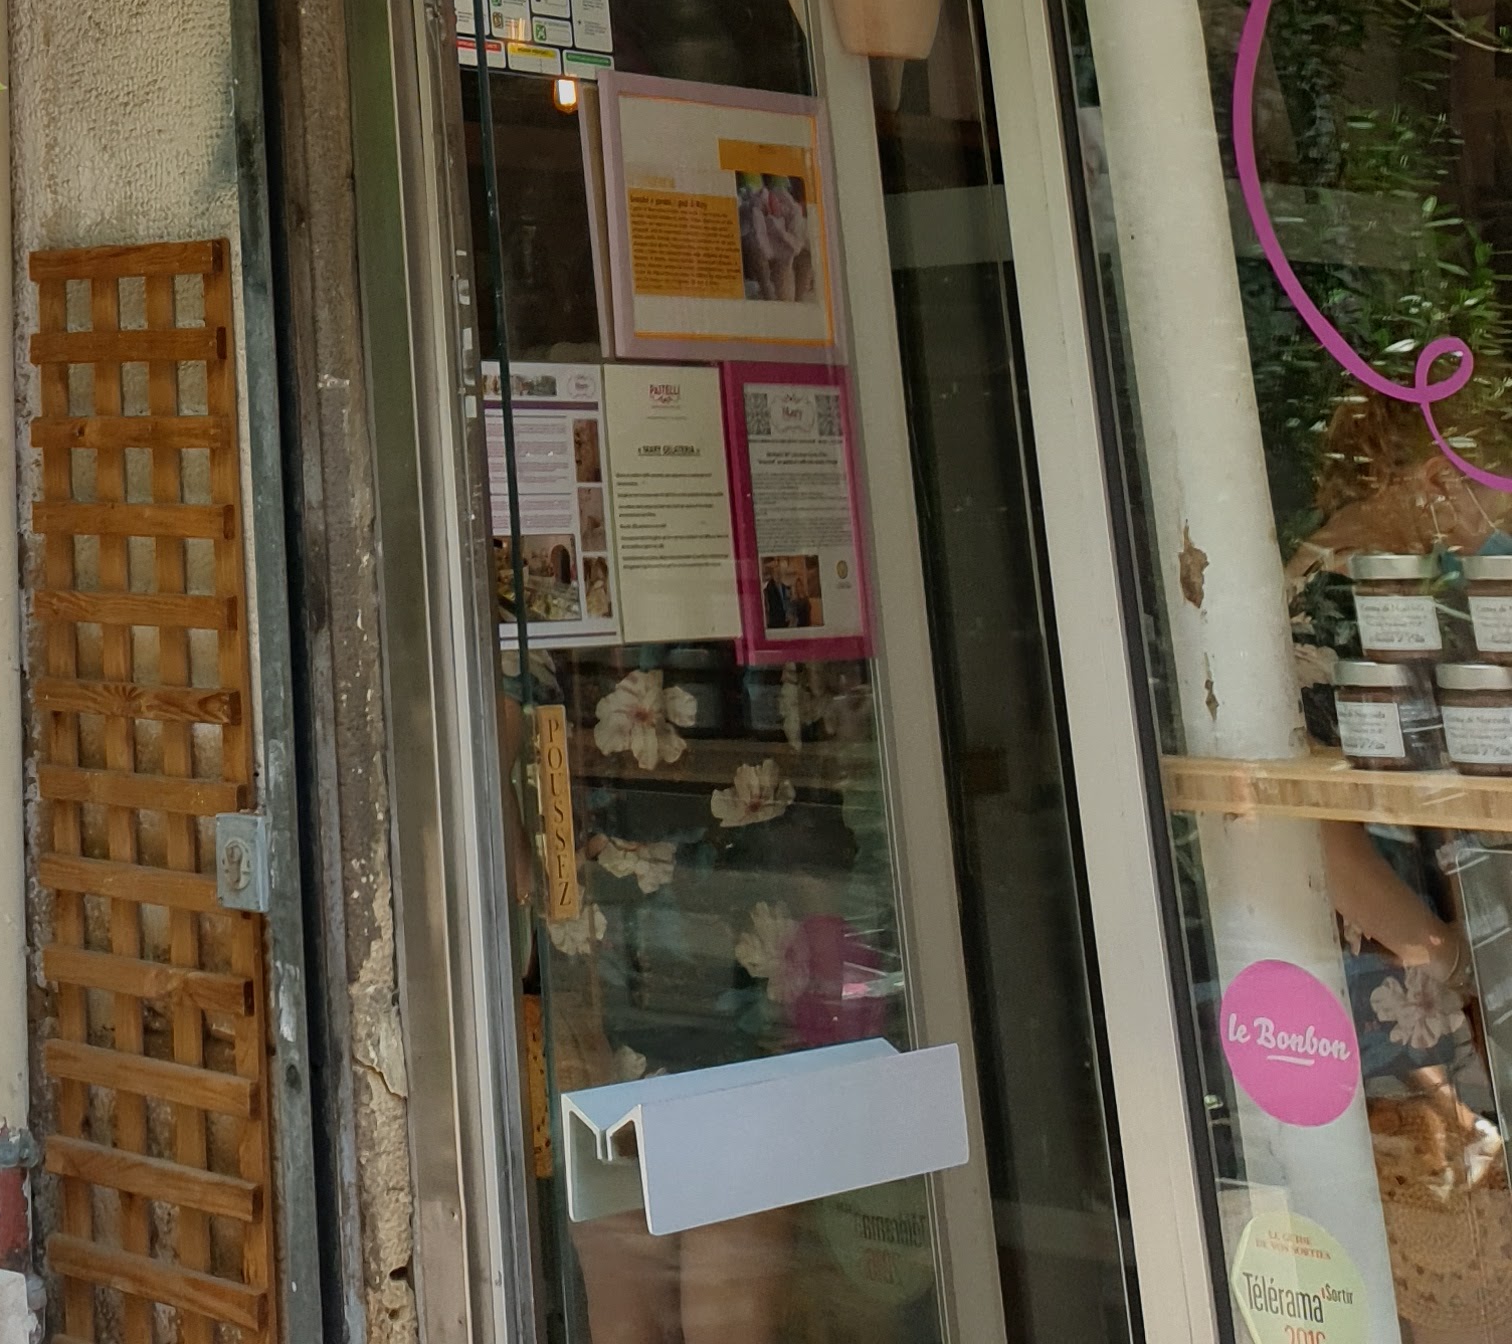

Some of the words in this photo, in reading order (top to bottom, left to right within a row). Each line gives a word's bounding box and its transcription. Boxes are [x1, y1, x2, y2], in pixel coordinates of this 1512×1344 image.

[1228, 1013, 1251, 1044] le
[1253, 1016, 1351, 1061] Bonbon
[1242, 1271, 1324, 1324] Télérama
